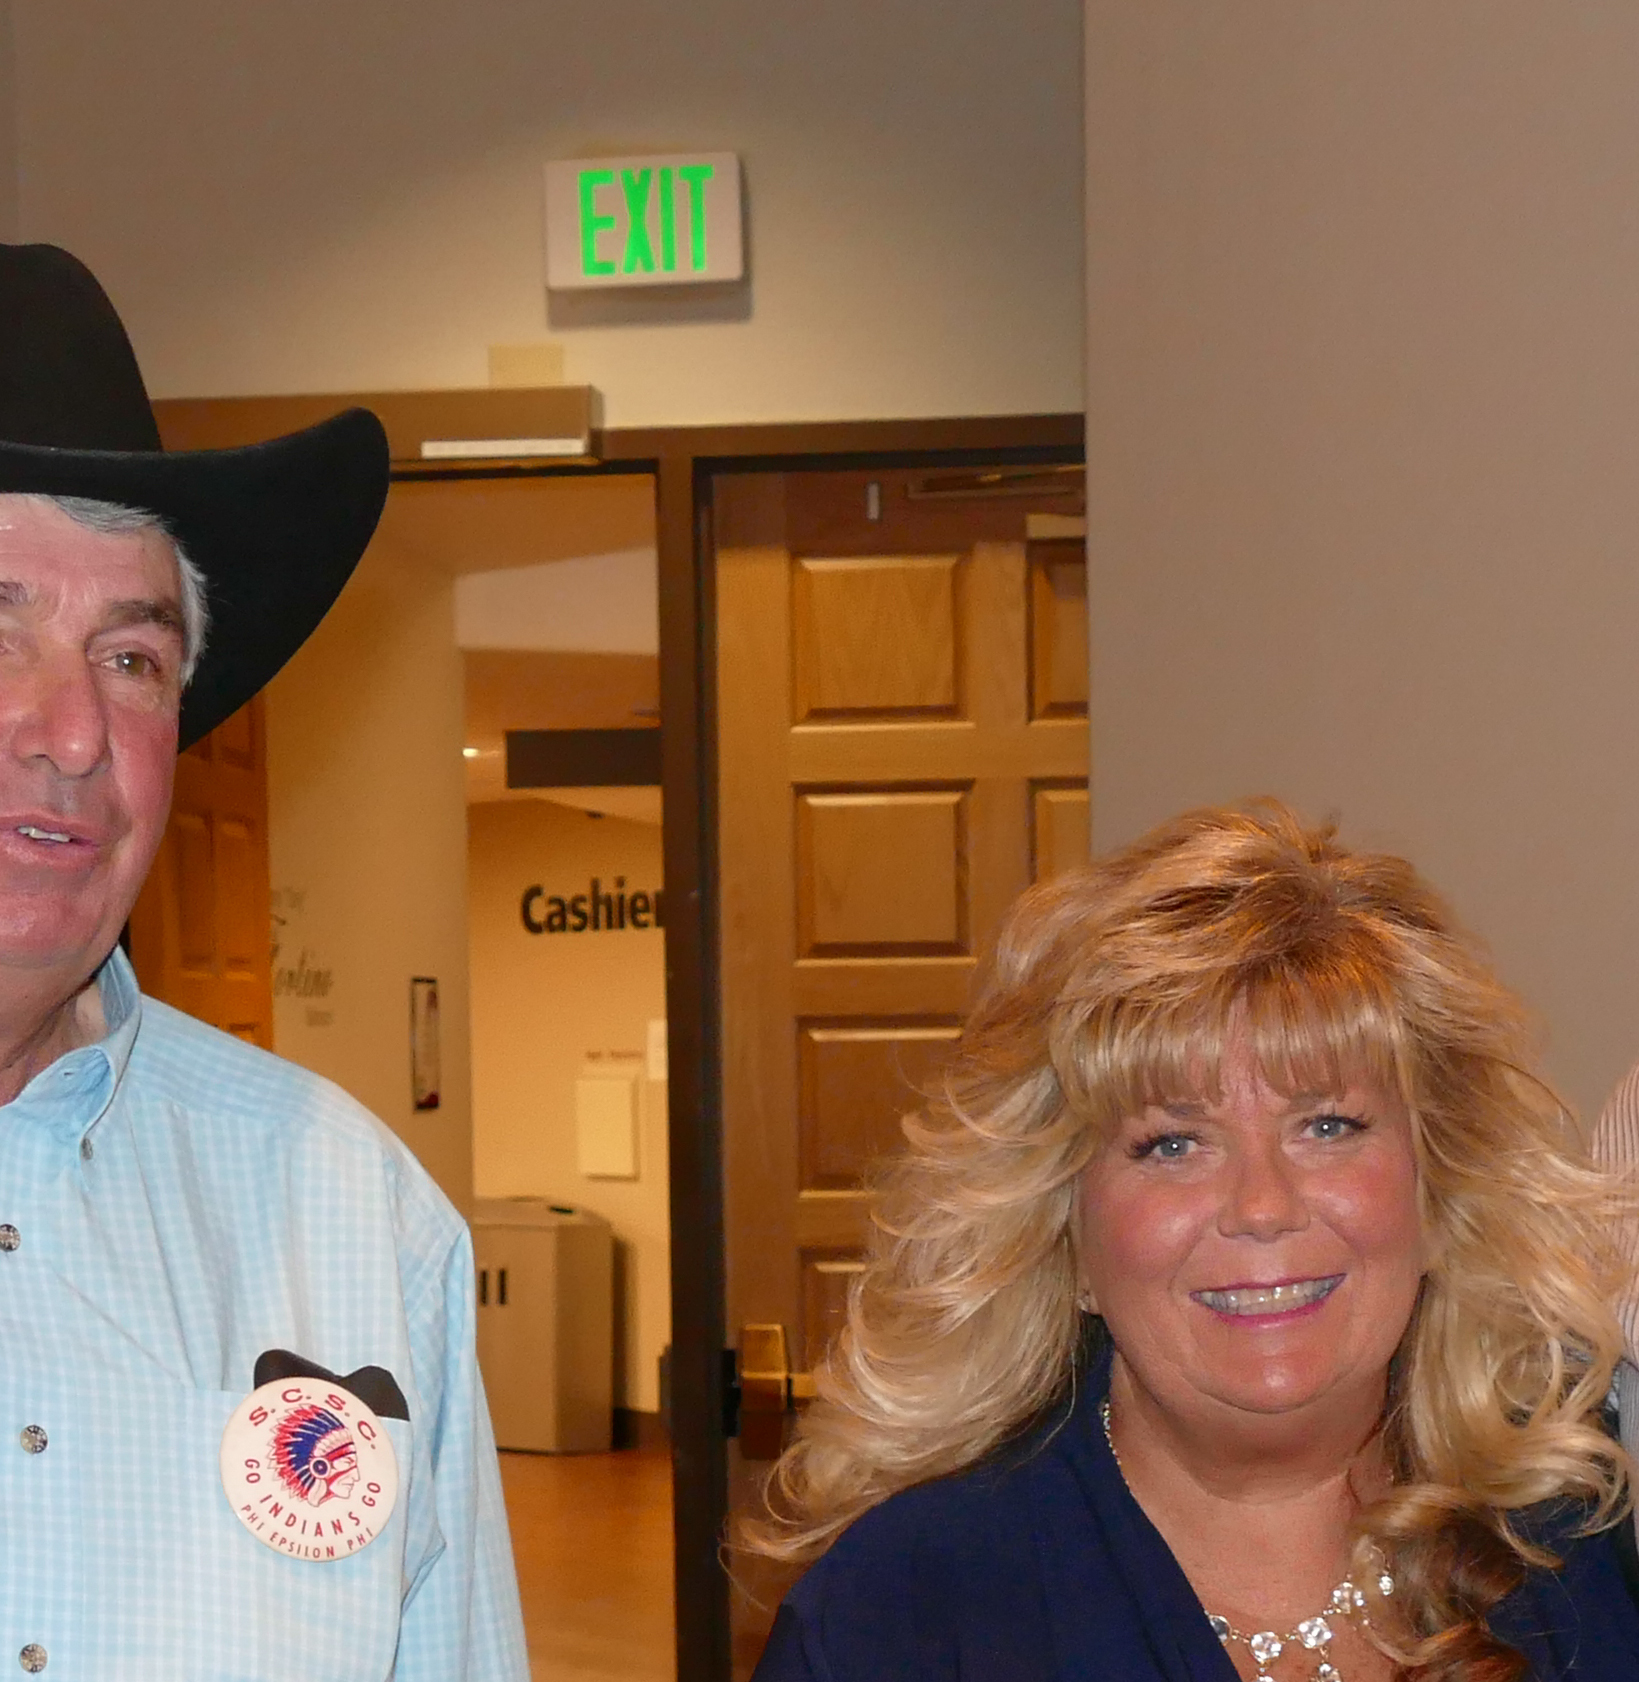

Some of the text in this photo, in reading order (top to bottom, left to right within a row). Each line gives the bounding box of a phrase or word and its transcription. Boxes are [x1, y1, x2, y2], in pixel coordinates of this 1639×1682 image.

[578, 165, 715, 276] EXIT
[241, 1504, 373, 1559] PHI EPSILON PHI
[245, 1458, 381, 1537] GO INDIANS GO
